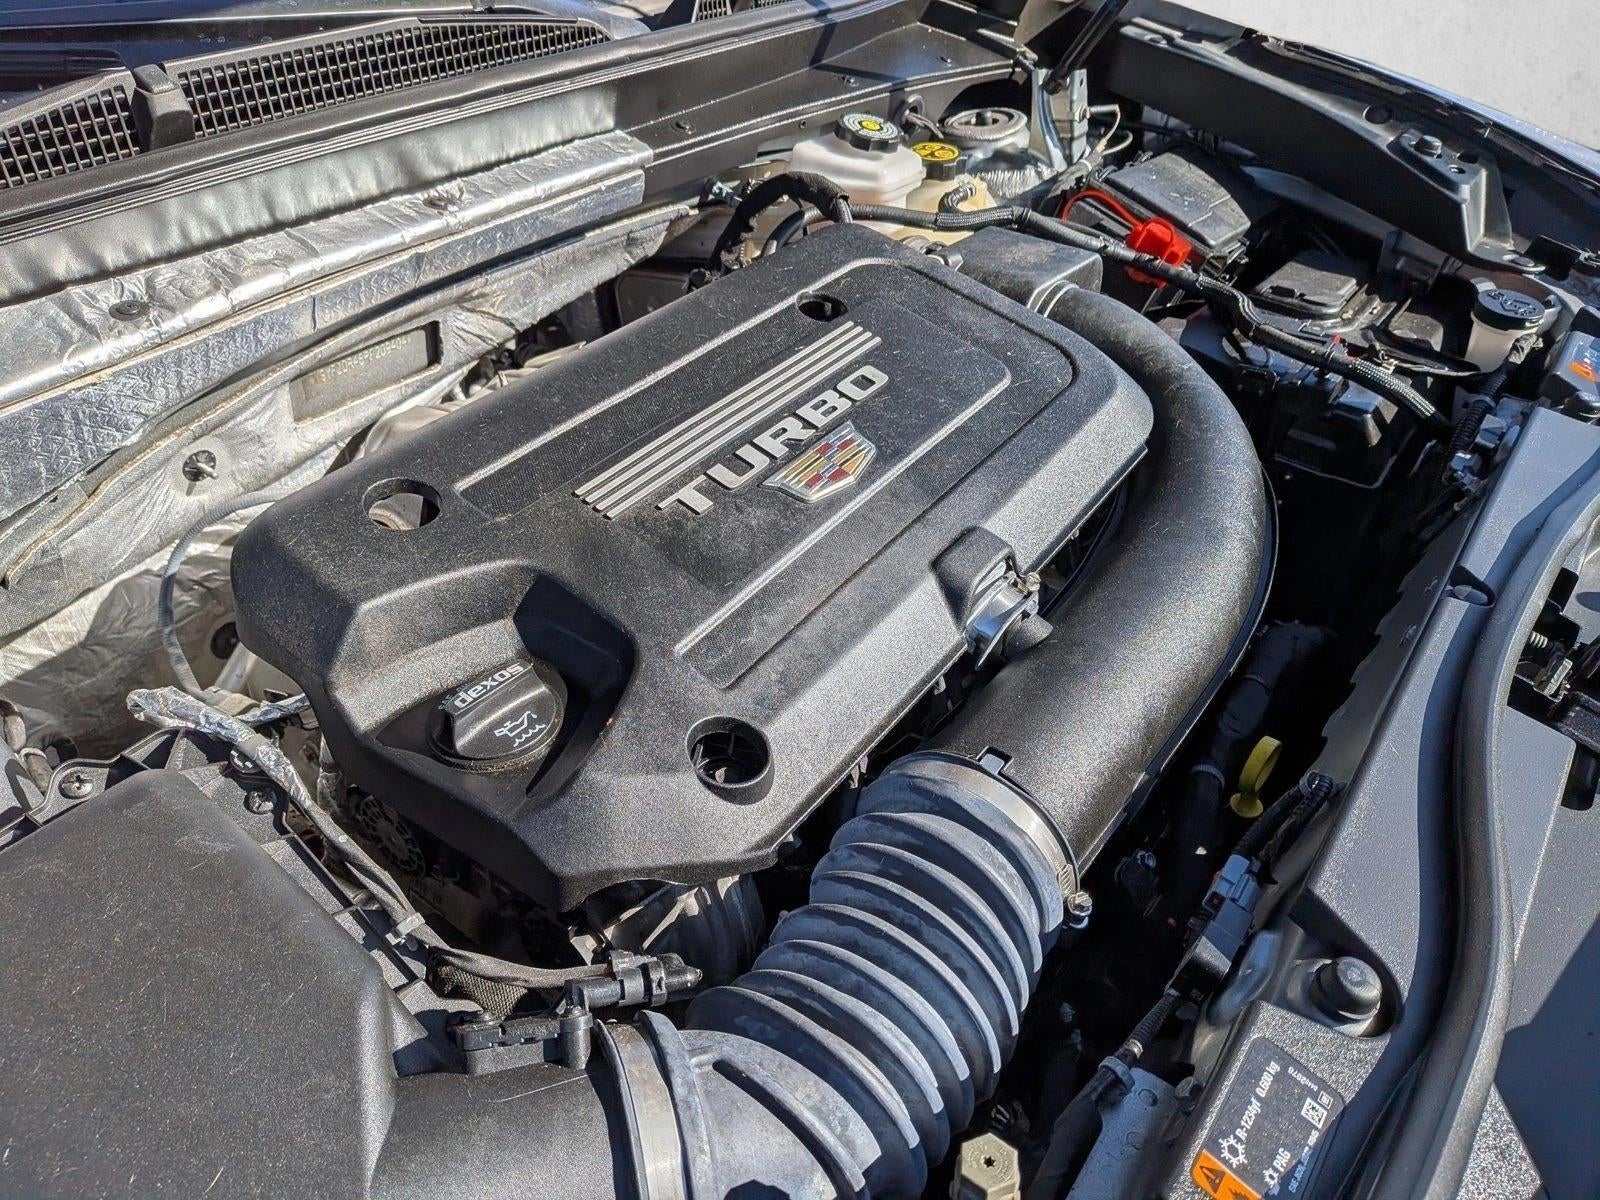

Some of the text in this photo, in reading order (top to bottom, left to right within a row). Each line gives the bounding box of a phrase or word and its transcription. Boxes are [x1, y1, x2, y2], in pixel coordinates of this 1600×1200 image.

[655, 365, 889, 514] TURBO
[454, 662, 523, 708] dexos
[1235, 1061, 1280, 1141] R-1234yf 0.600 kg
[1272, 1147, 1291, 1173] PAG
